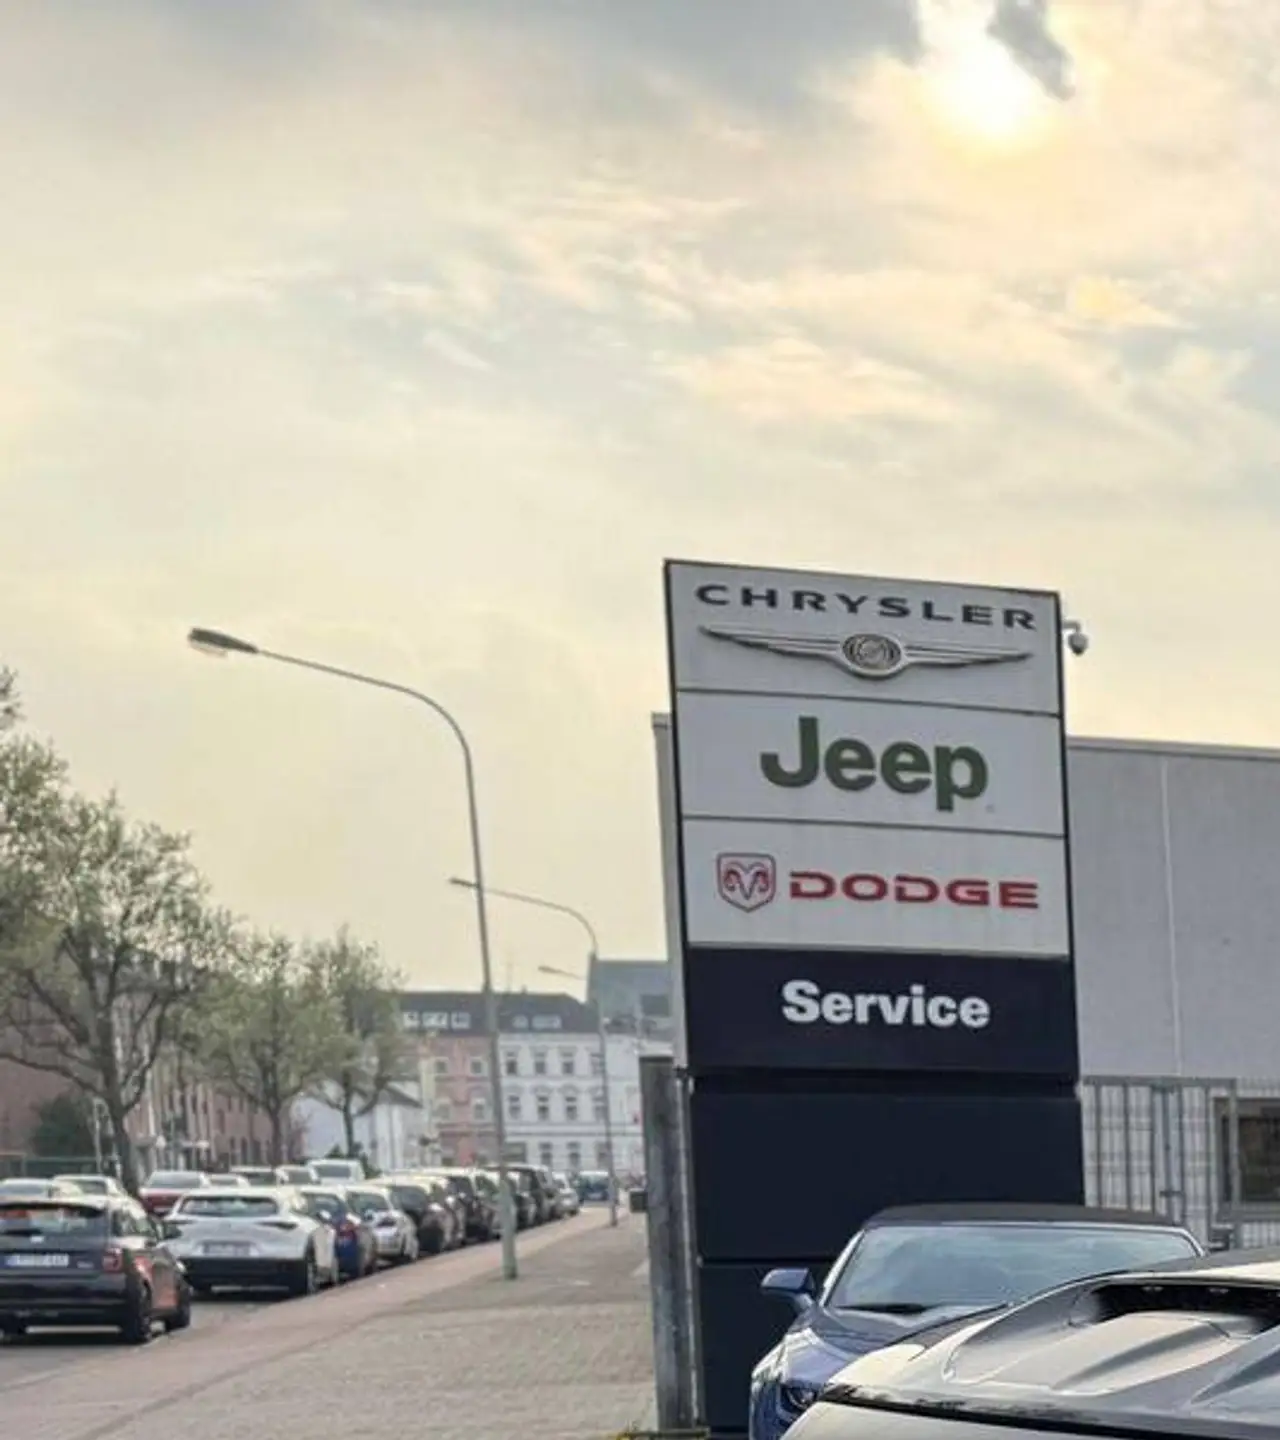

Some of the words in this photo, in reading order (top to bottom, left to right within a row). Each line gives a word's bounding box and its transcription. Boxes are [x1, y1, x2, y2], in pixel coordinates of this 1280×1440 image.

[696, 585, 1036, 629] CHRYSLER
[760, 717, 988, 811] Jeep
[790, 871, 1038, 909] DODGE
[781, 978, 990, 1029] Service
